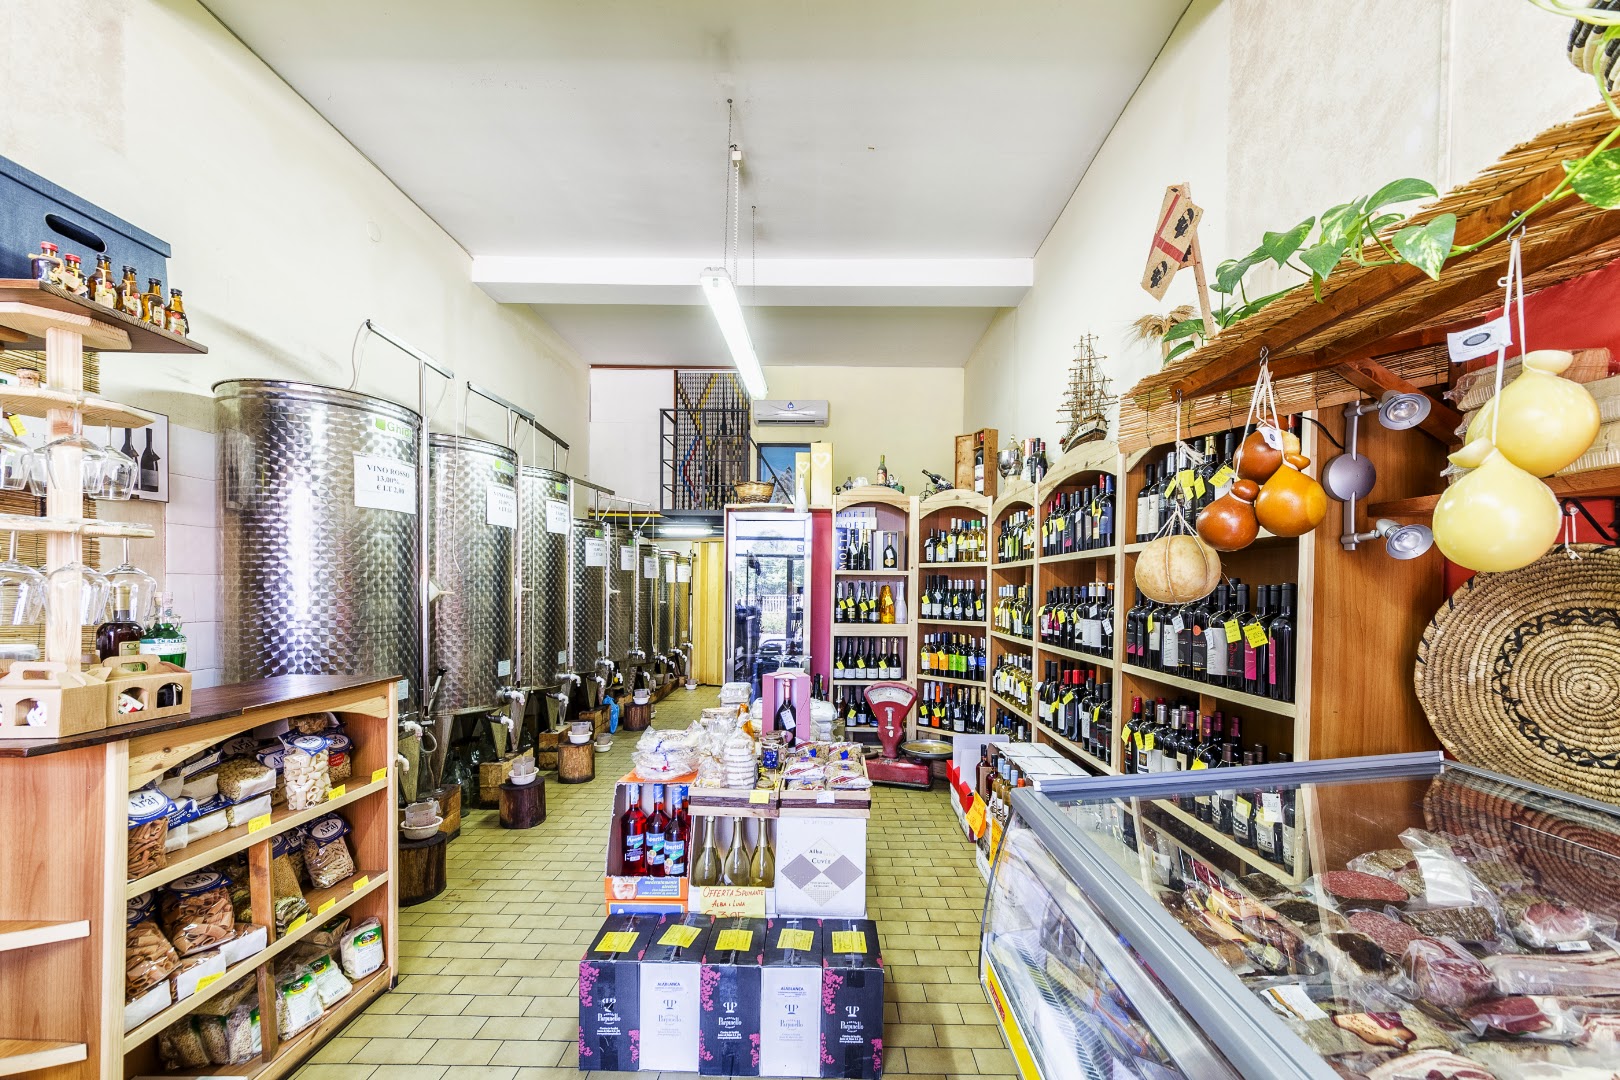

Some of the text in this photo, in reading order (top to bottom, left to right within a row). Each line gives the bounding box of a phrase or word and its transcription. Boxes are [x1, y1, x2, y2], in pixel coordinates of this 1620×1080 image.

[367, 464, 389, 474] VINO
[232, 739, 256, 753] Araj
[131, 796, 159, 810] Araj
[320, 822, 339, 836] Araj
[184, 873, 213, 887] Araj
[703, 886, 764, 898] OFFERTA SPUMANTE
